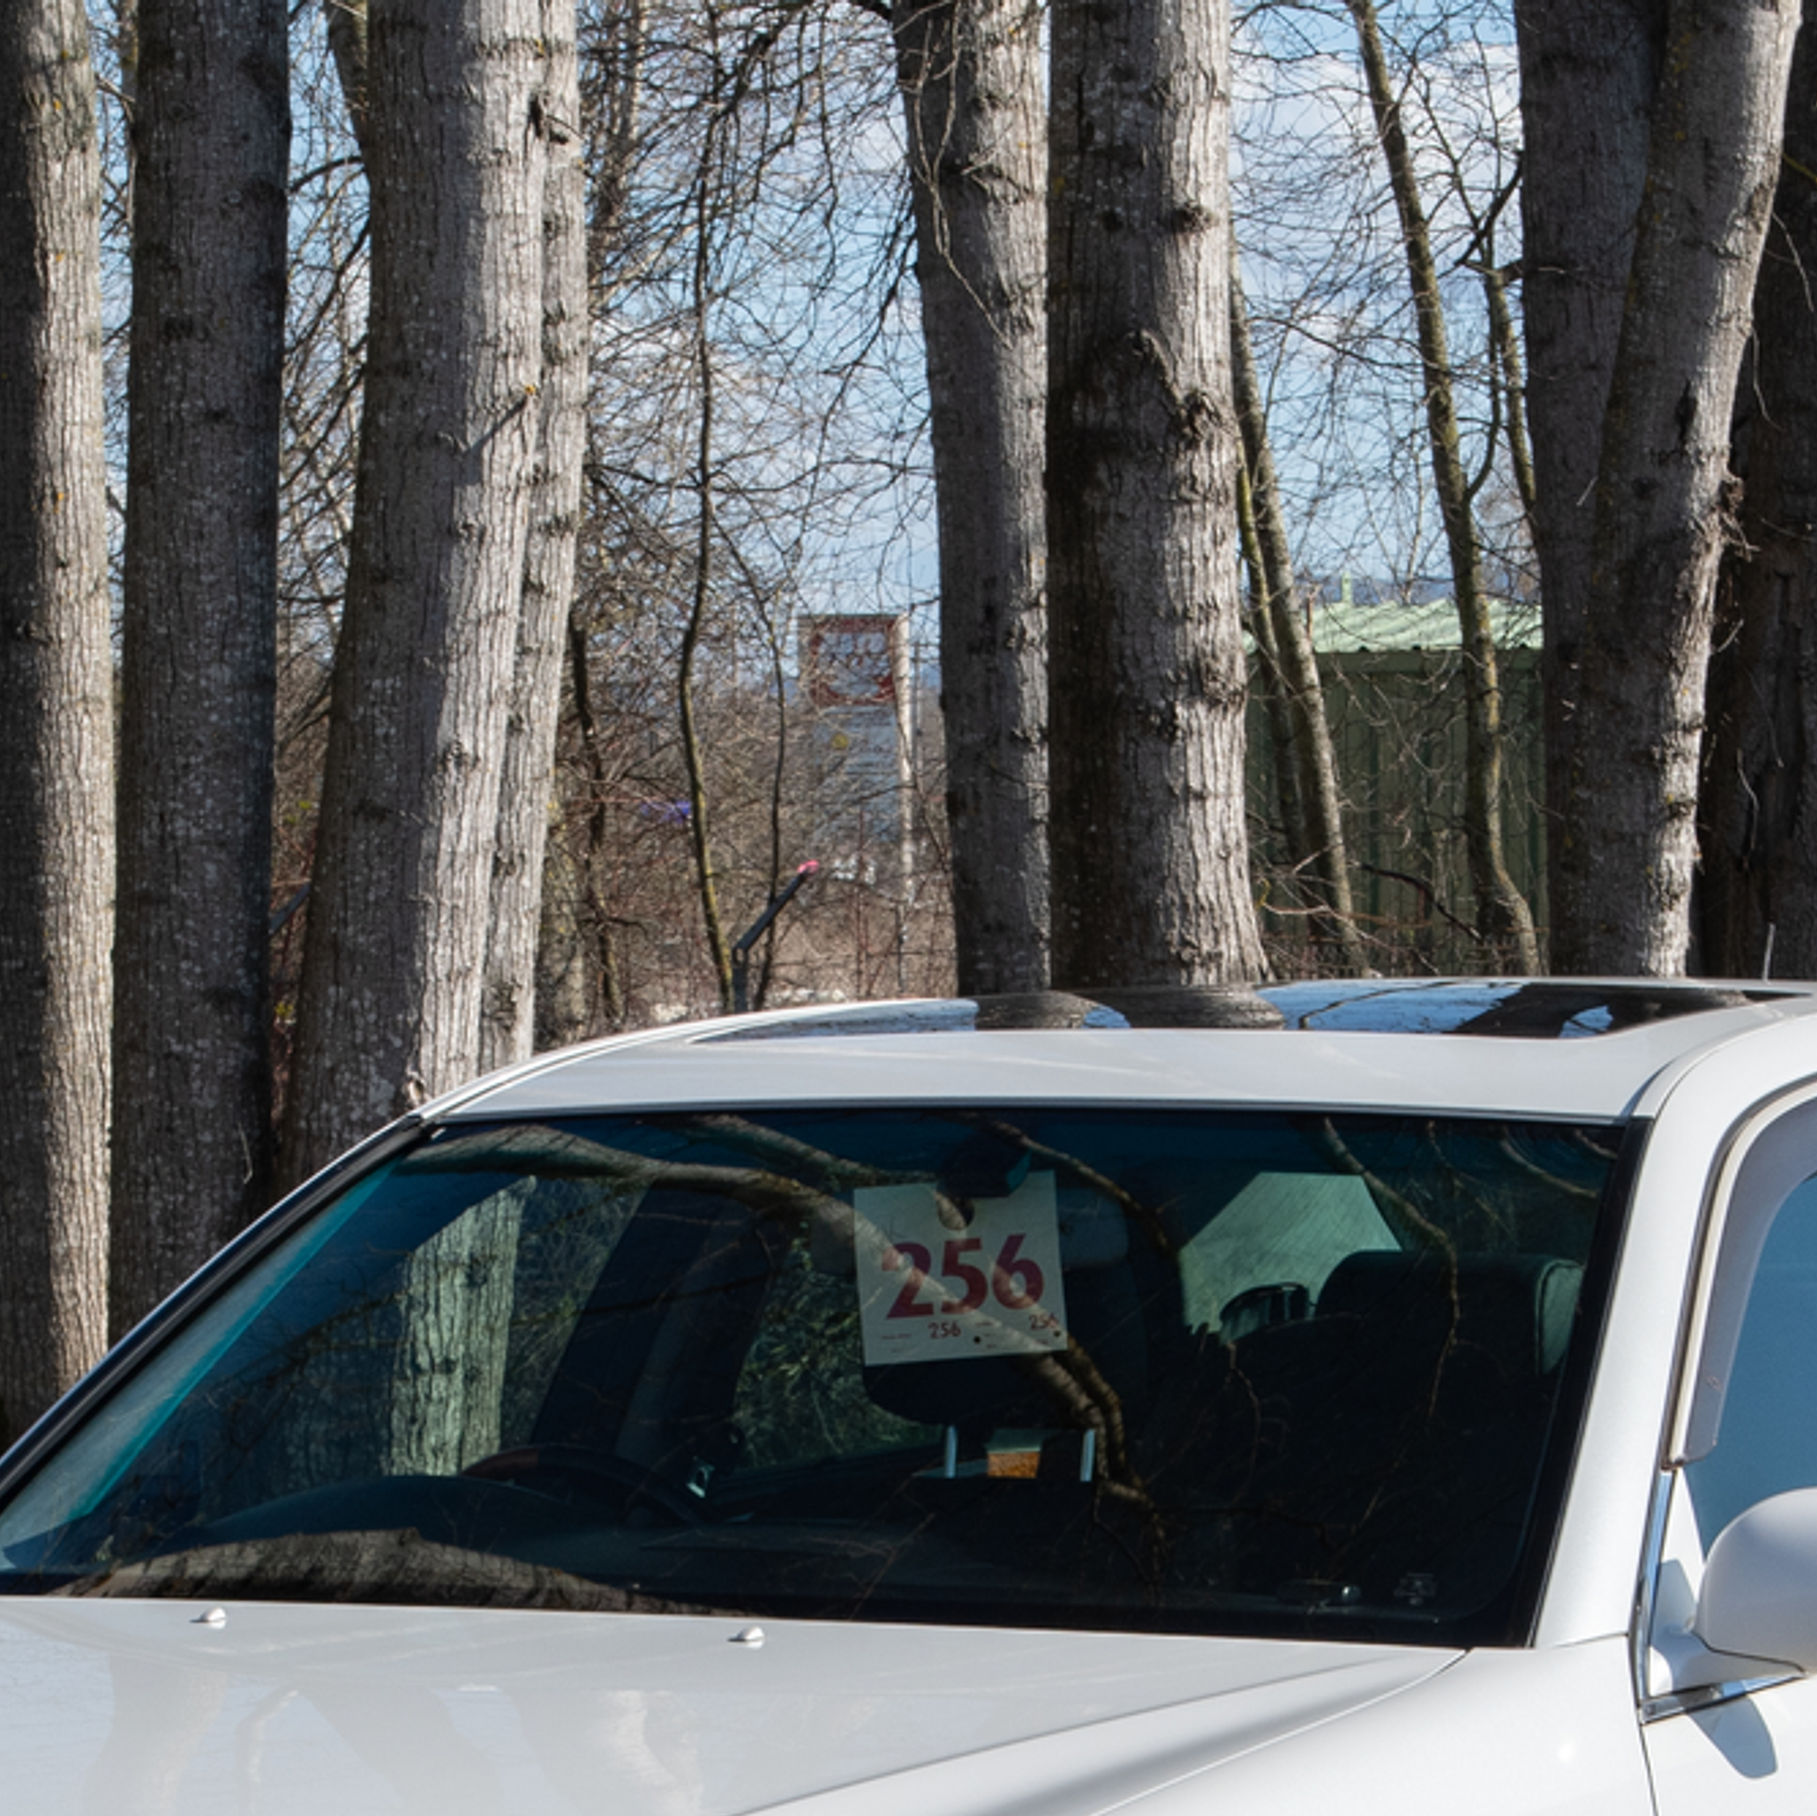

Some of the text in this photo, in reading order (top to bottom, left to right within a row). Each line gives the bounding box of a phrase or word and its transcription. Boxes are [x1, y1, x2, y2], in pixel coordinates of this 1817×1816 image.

[881, 1233, 1044, 1320] 256
[928, 1321, 962, 1339] 256
[1029, 1312, 1058, 1330] 256
